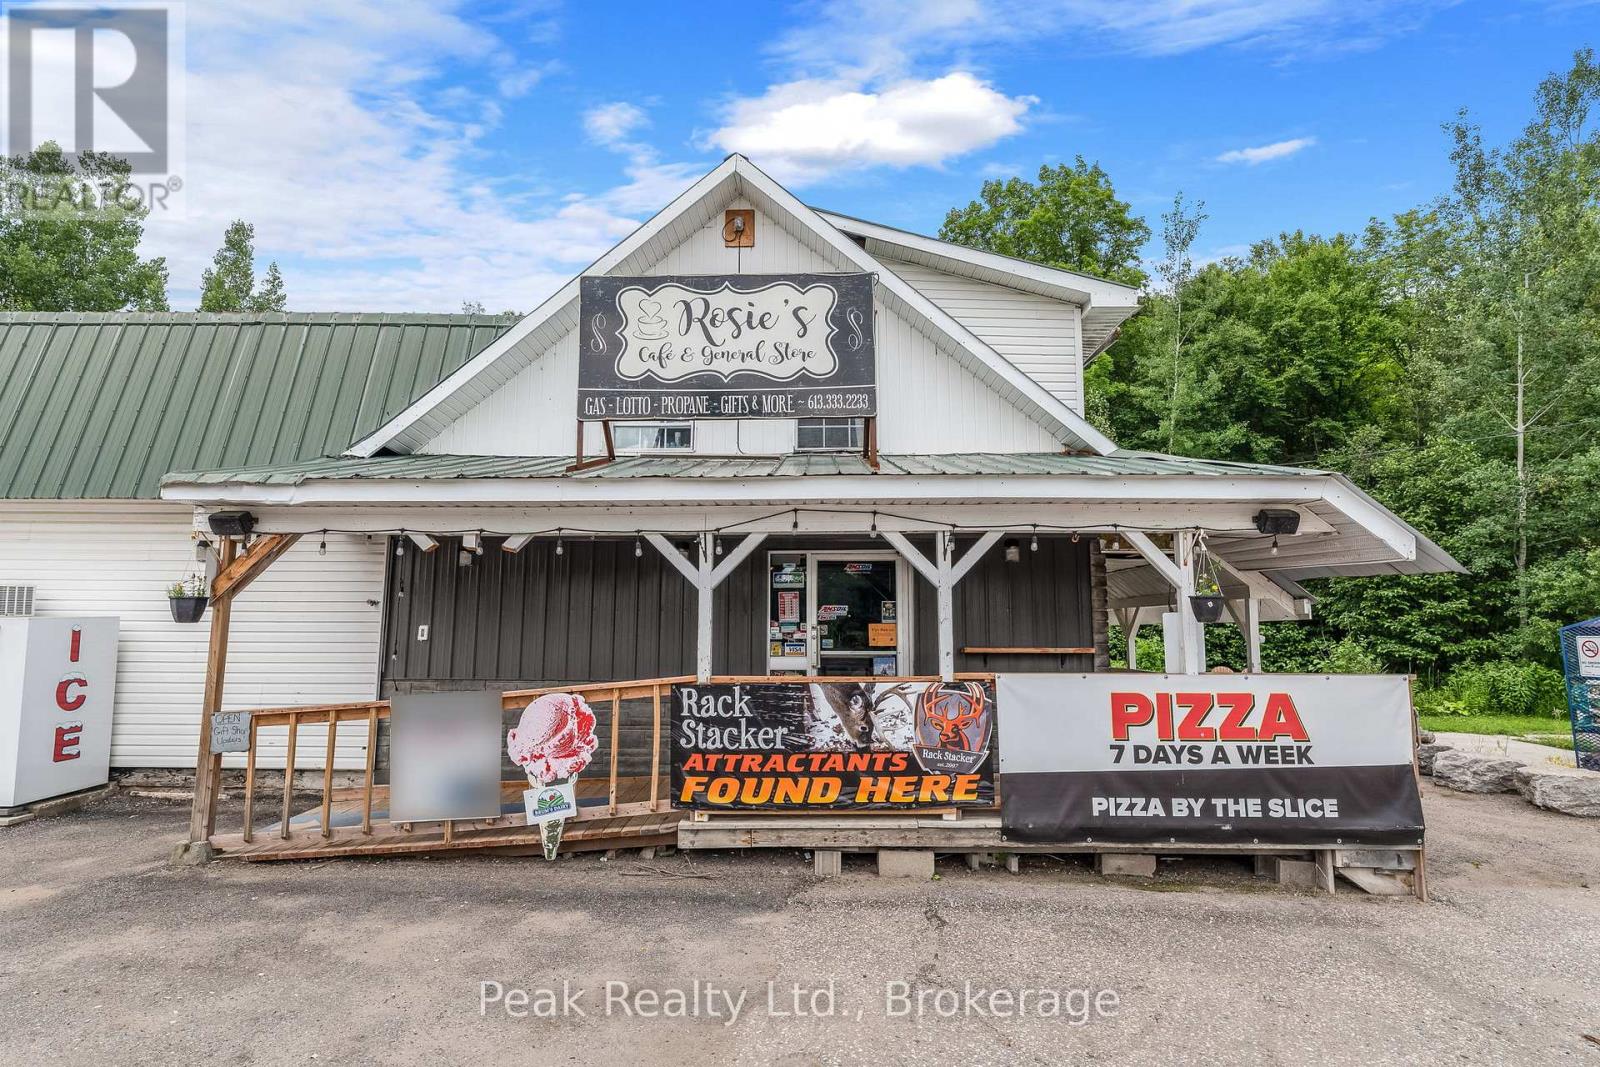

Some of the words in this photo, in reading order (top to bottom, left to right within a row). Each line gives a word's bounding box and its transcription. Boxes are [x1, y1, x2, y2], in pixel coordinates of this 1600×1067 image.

[673, 297, 817, 347] Rosie's
[681, 347, 694, 362] &
[701, 340, 766, 366] General
[768, 341, 816, 365] Store
[585, 396, 606, 415] GAS
[616, 396, 651, 415] LOTTO
[661, 395, 711, 414] PROPANE
[720, 395, 749, 414] GIFTS
[752, 394, 759, 410] &
[762, 394, 795, 413] MORE
[808, 393, 869, 410] 613.333.2233
[52, 623, 88, 763] ICE
[680, 685, 753, 717] Rack
[1110, 692, 1311, 742] PIZZA
[680, 718, 789, 749] Stacker
[682, 753, 909, 773] ATTRACTANTS
[922, 749, 942, 760] Rack
[944, 752, 974, 763] Stacker
[1109, 744, 1125, 764] 7
[1133, 744, 1203, 765] DAYS
[1211, 745, 1231, 765] A
[1236, 744, 1314, 765] WEEK
[680, 776, 842, 805] FOUND
[855, 774, 981, 804] HERE
[1092, 797, 1165, 817] PIZZA
[1172, 798, 1205, 817] BY
[1212, 798, 1262, 818] THE
[1269, 798, 1339, 818] SLICE
